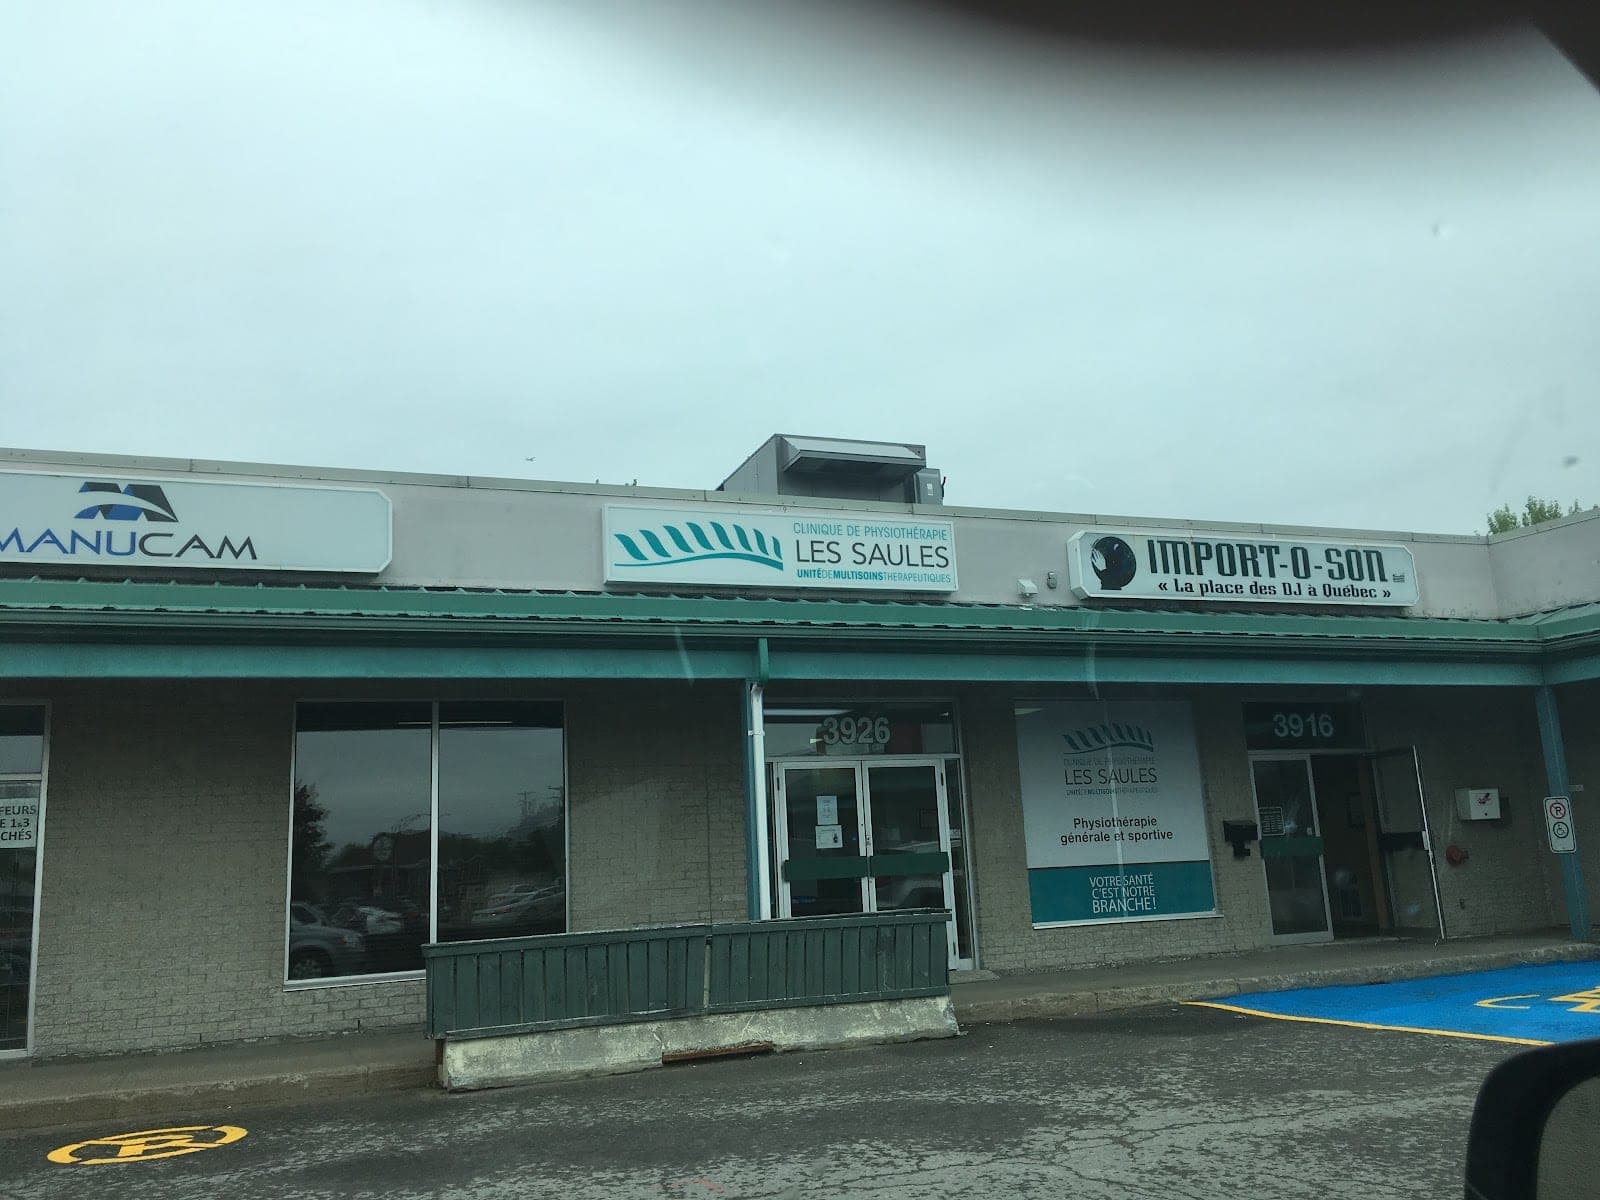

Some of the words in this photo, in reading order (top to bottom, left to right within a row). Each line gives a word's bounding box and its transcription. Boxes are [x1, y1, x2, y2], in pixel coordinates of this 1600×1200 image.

[793, 522, 843, 536] CLINIQUE
[846, 525, 861, 537] DE
[864, 525, 948, 541] PHYSIOTHÉRAPIE
[796, 539, 842, 564] LES
[851, 542, 950, 569] SAULES
[1174, 578, 1195, 593] La
[1199, 579, 1245, 597] place
[1249, 581, 1277, 596] des
[1283, 583, 1302, 596] DJ
[1307, 583, 1316, 597] à
[1322, 583, 1377, 599] Québec
[822, 716, 891, 745] 3926
[1272, 712, 1335, 738] 3916
[1064, 769, 1093, 786] LES
[1097, 767, 1158, 785] SAULES
[1073, 816, 1158, 831] Physiothérapie
[1060, 831, 1111, 846] générale
[1114, 831, 1125, 841] et
[1128, 829, 1174, 843] sportive
[1089, 875, 1121, 888] VOTRE
[1123, 871, 1154, 886] SANTÉ
[1091, 887, 1120, 899] C'EST
[1122, 885, 1155, 897] NOTRE
